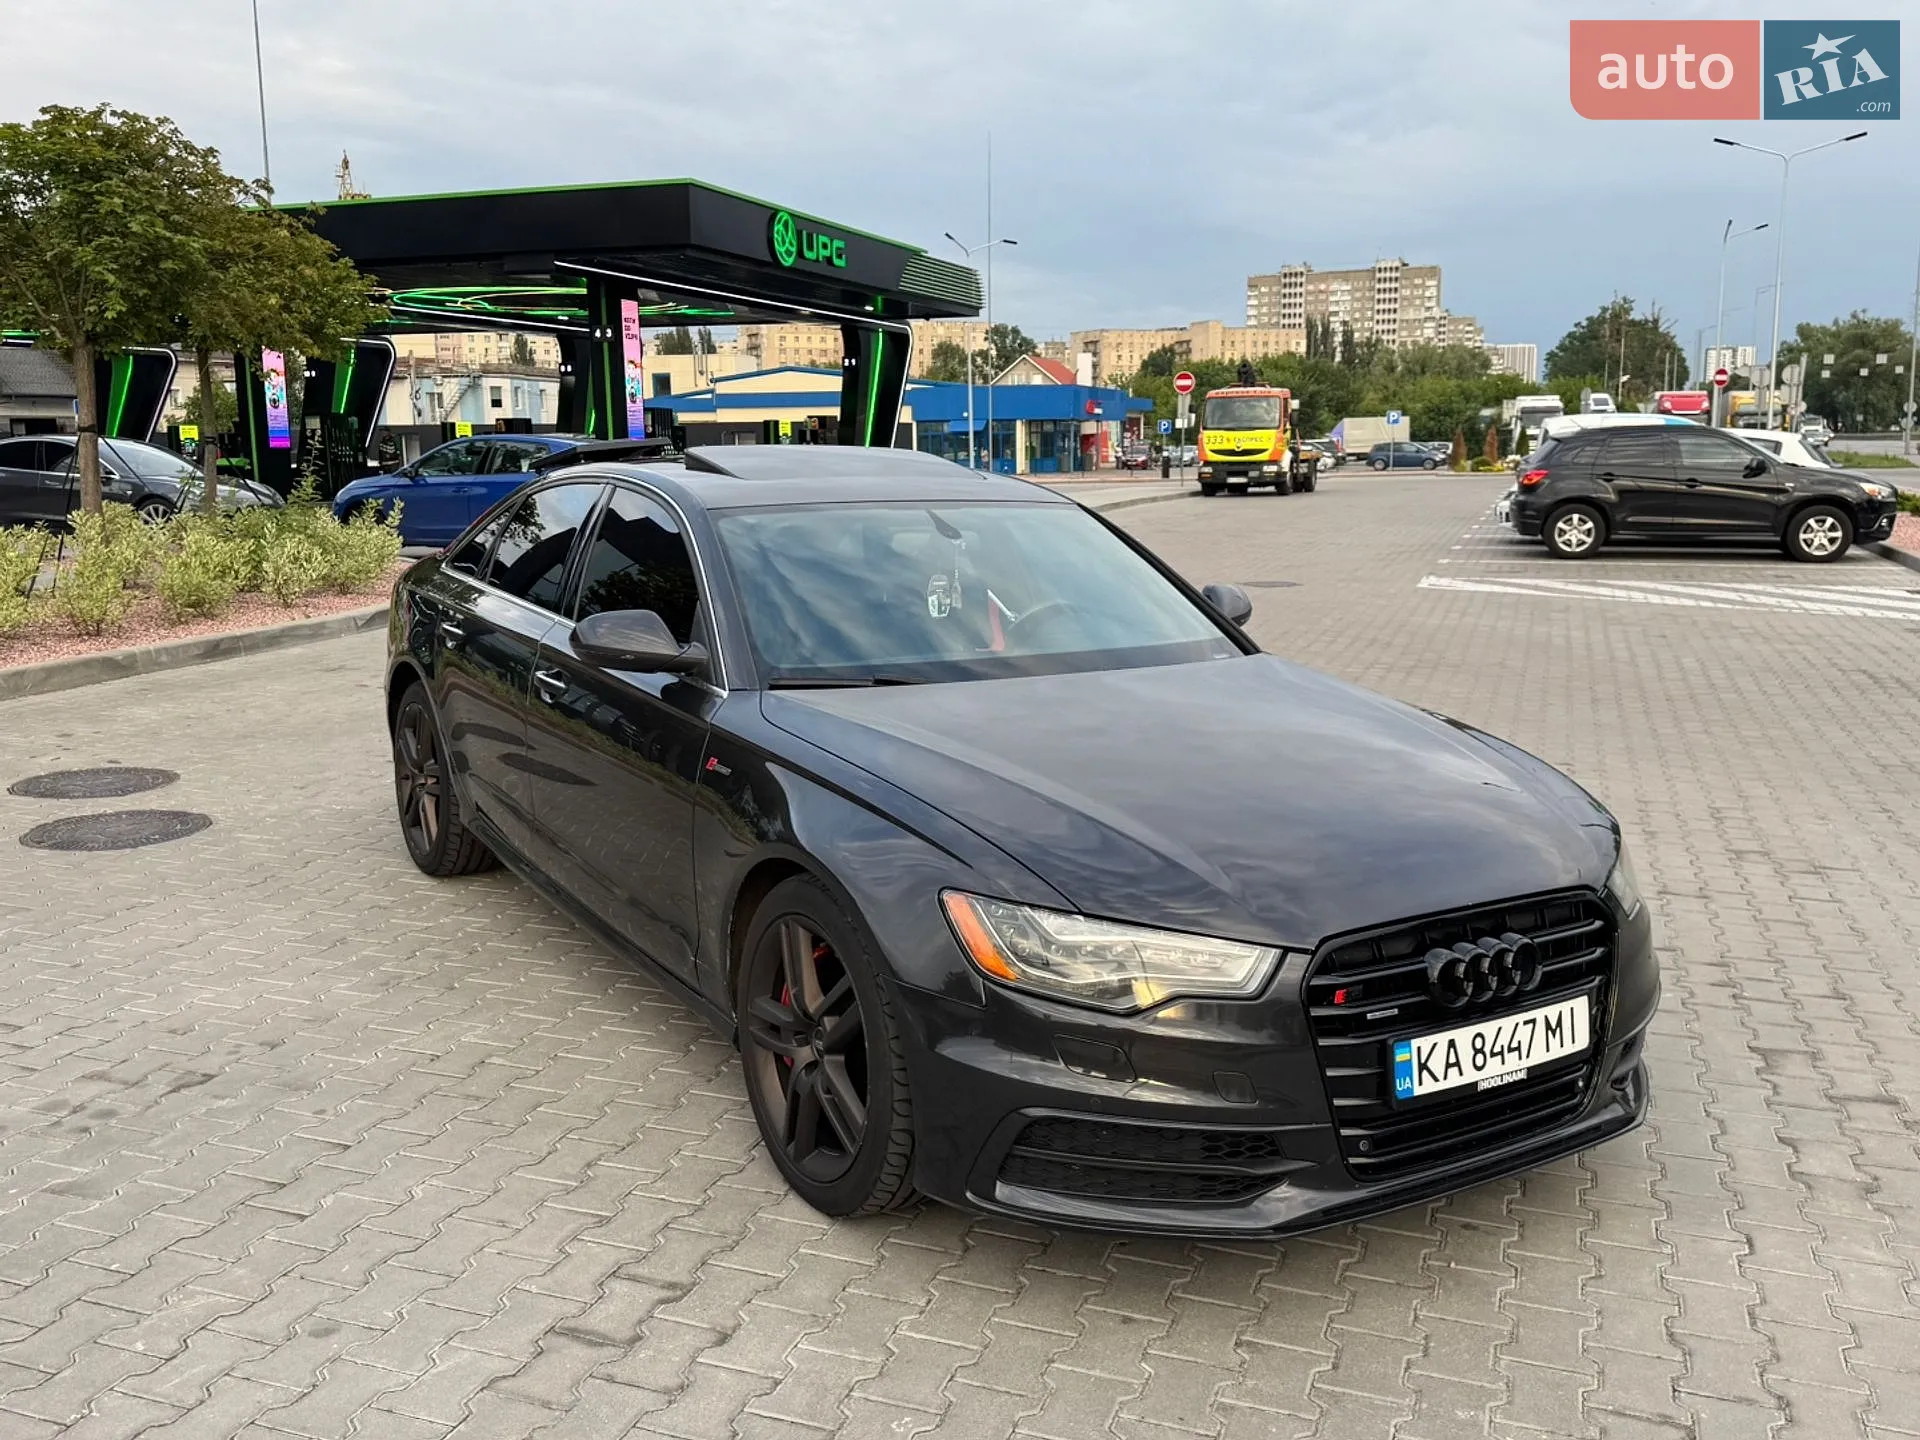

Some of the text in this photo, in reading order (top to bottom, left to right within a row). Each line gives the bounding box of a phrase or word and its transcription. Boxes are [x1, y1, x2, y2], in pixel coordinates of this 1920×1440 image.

[802, 230, 847, 268] UPG
[594, 328, 601, 338] 4
[1417, 1038, 1464, 1087] KA
[1471, 1019, 1537, 1072] 8447
[1396, 1076, 1412, 1091] UA
